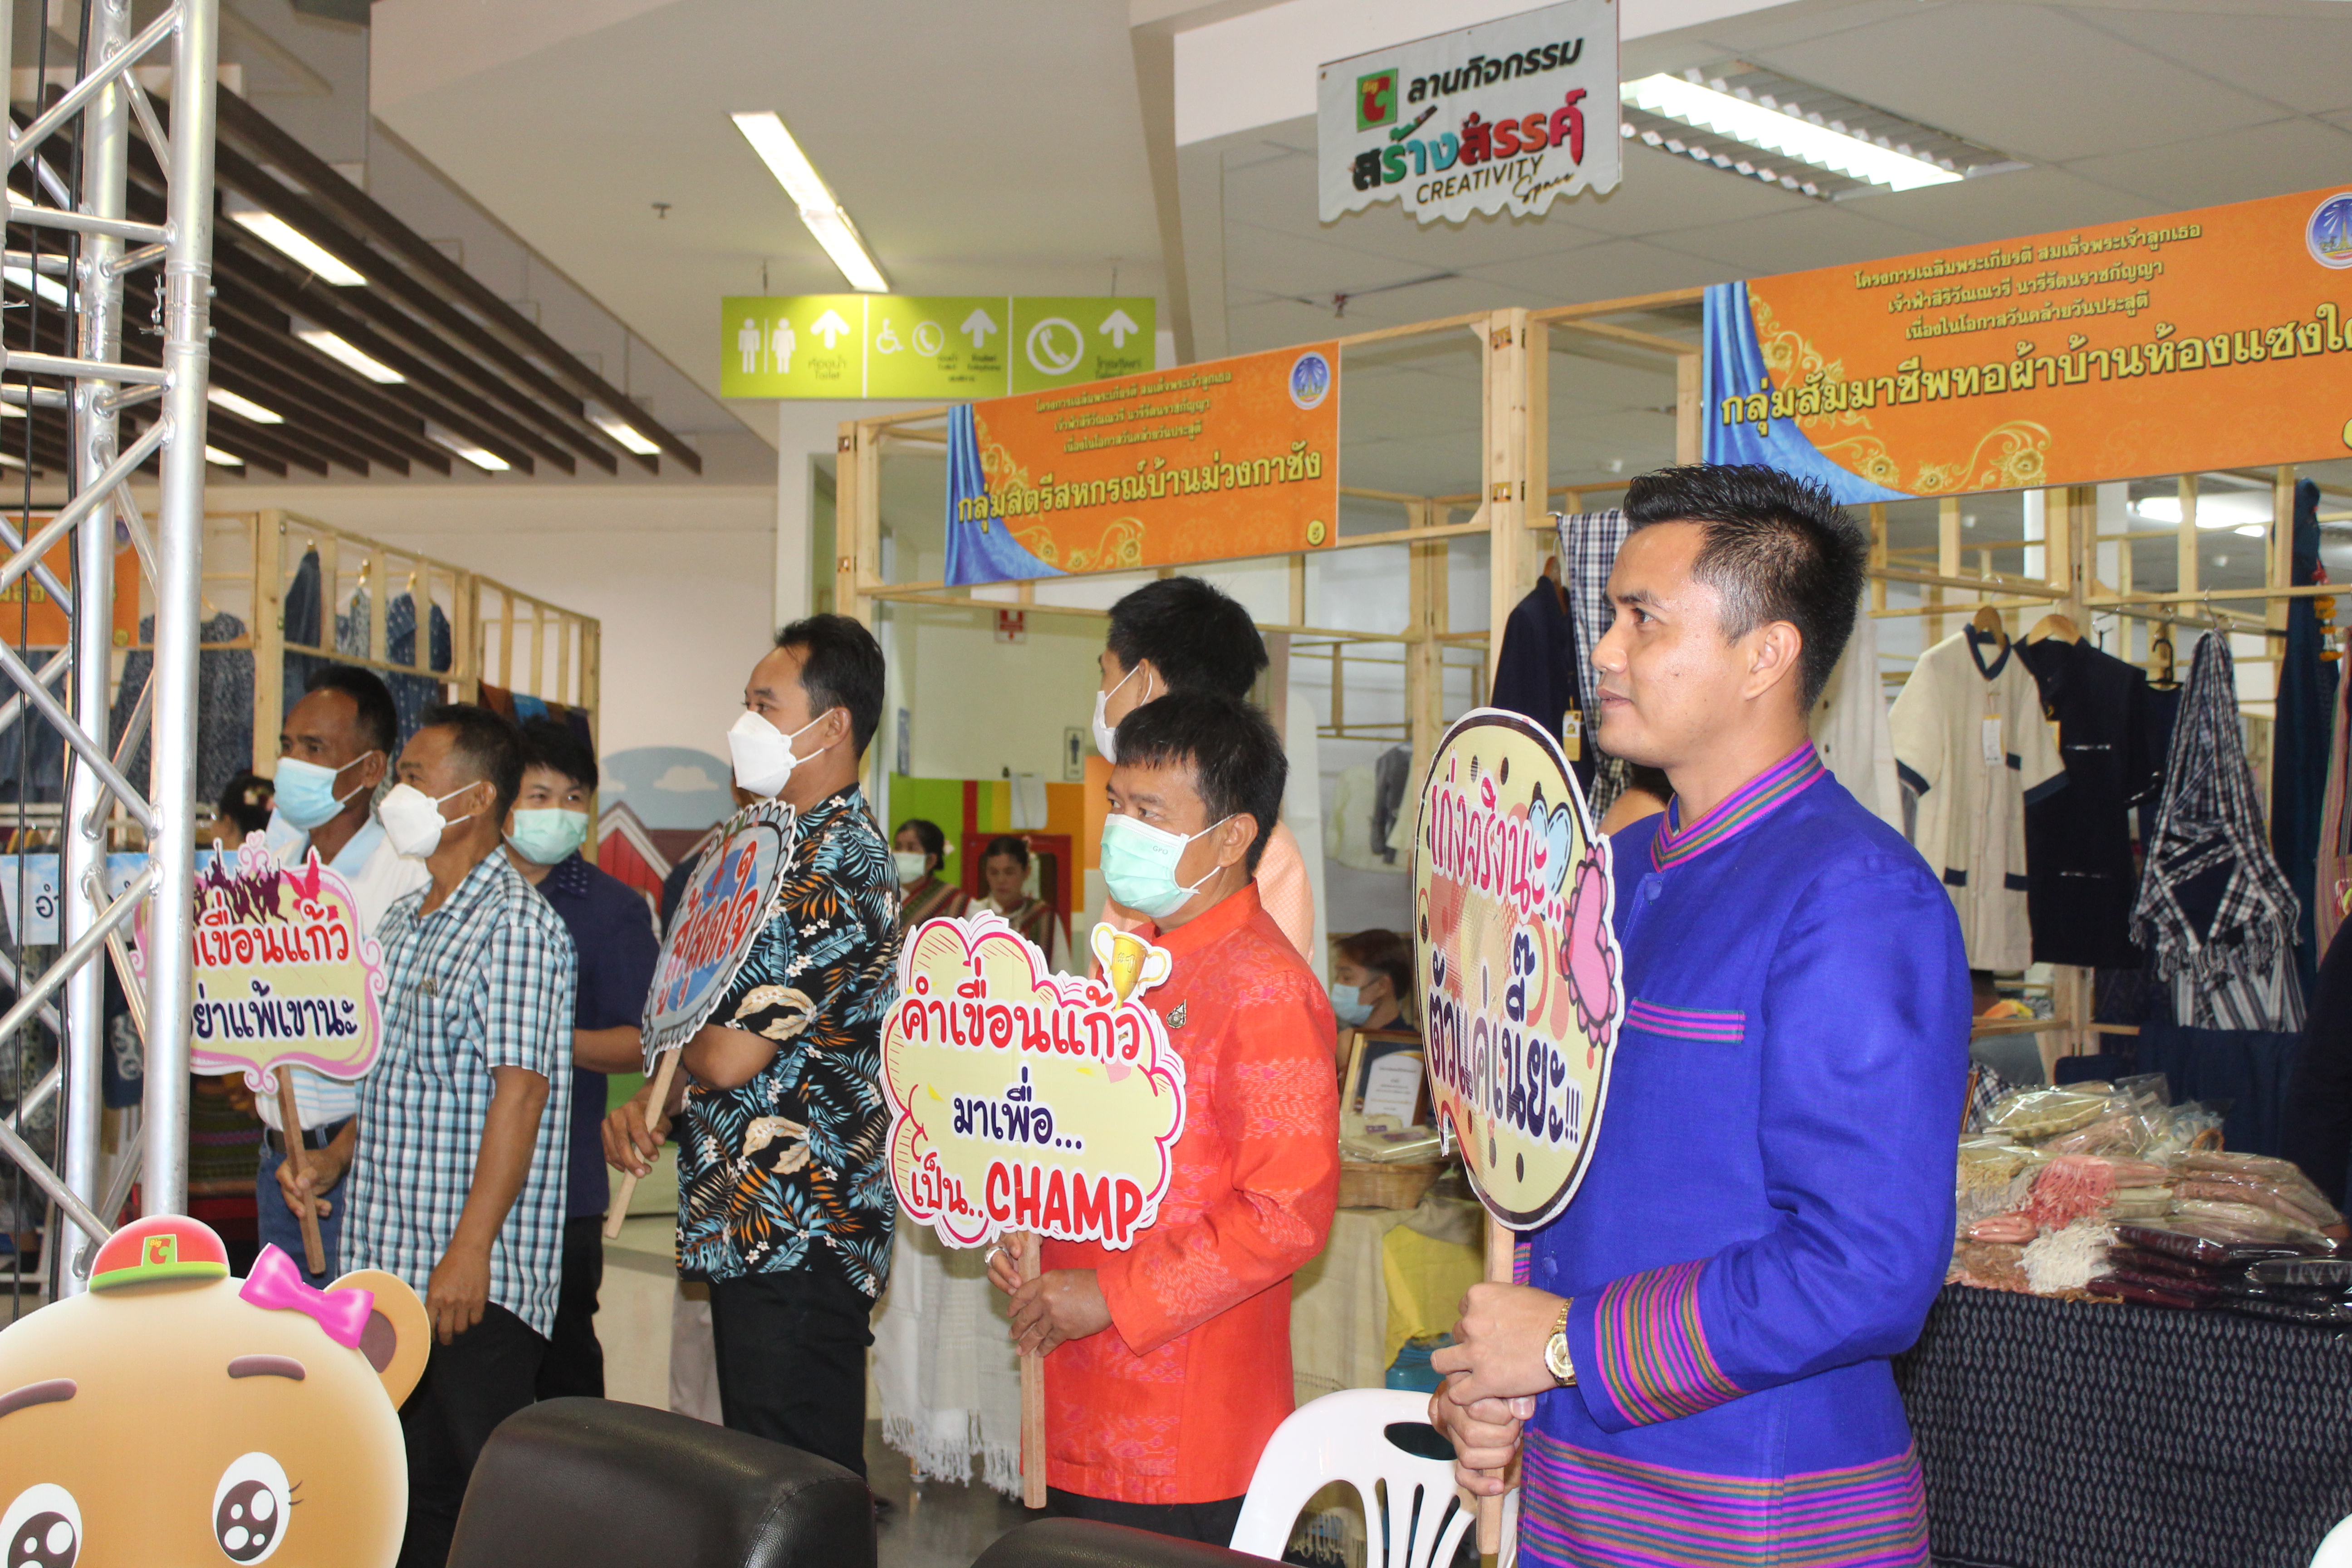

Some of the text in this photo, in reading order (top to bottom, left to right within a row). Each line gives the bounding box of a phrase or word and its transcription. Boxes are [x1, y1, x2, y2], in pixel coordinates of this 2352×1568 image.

[1407, 38, 1583, 103] ลานกิจกรรม
[1352, 88, 1587, 191] สร้างสรรค์
[1416, 154, 1544, 204] CREATIVITY
[192, 891, 348, 966] เขื่อนแก้ว
[191, 981, 358, 1039] ย่าแพ้เขานะ
[902, 957, 1140, 1060] คำเขื่อนแก้ว
[954, 1067, 1082, 1150] มาเพื่อ...
[985, 1161, 1143, 1243] CHAMP
[149, 1239, 162, 1247] Big
